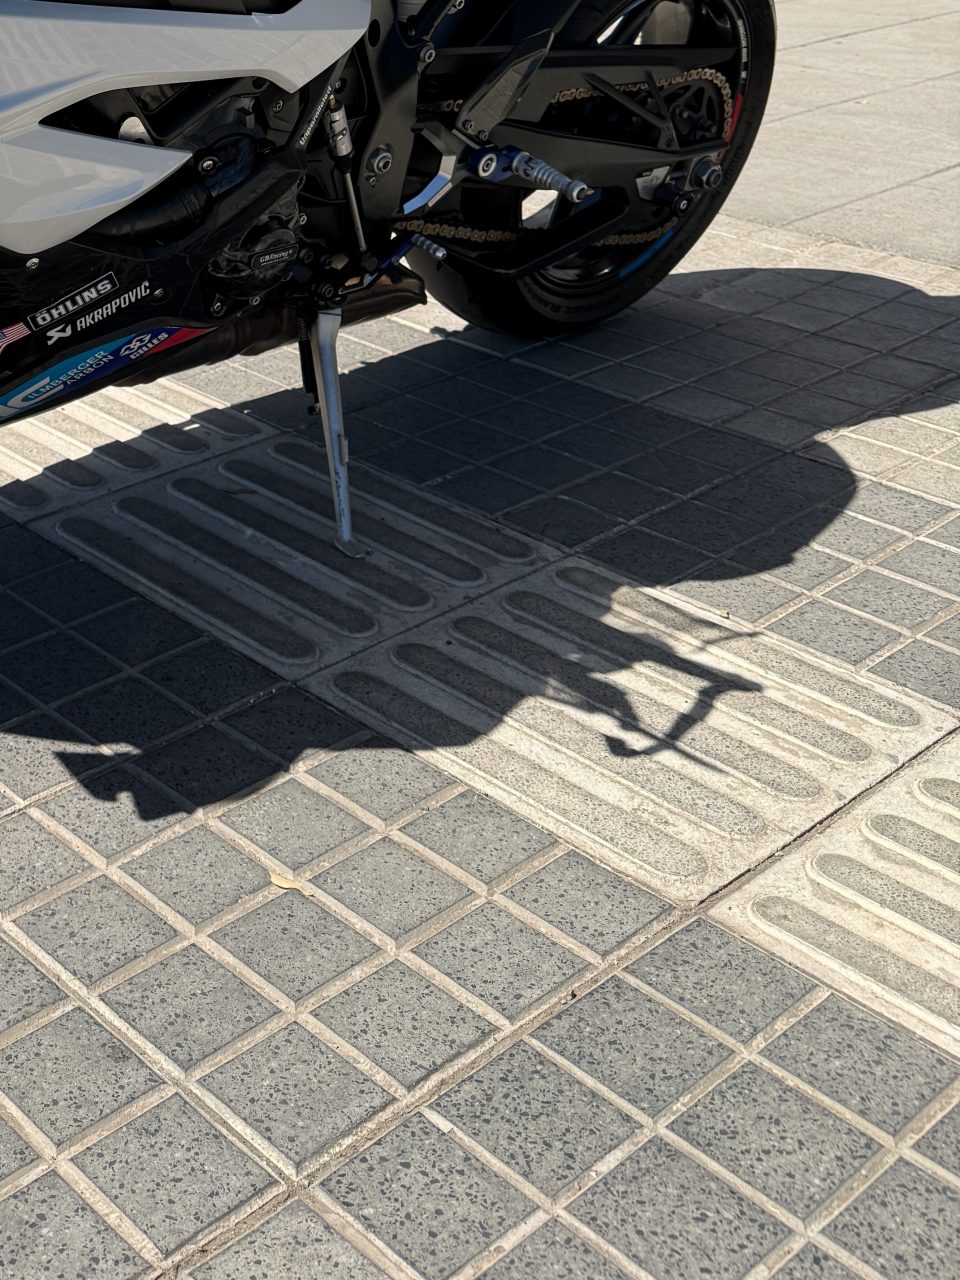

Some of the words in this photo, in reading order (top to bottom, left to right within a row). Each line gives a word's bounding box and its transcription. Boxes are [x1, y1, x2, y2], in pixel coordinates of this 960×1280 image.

[35, 279, 113, 326] ÖHLINS
[129, 332, 169, 360] GILLES
[27, 351, 110, 399] ILMBERGER
